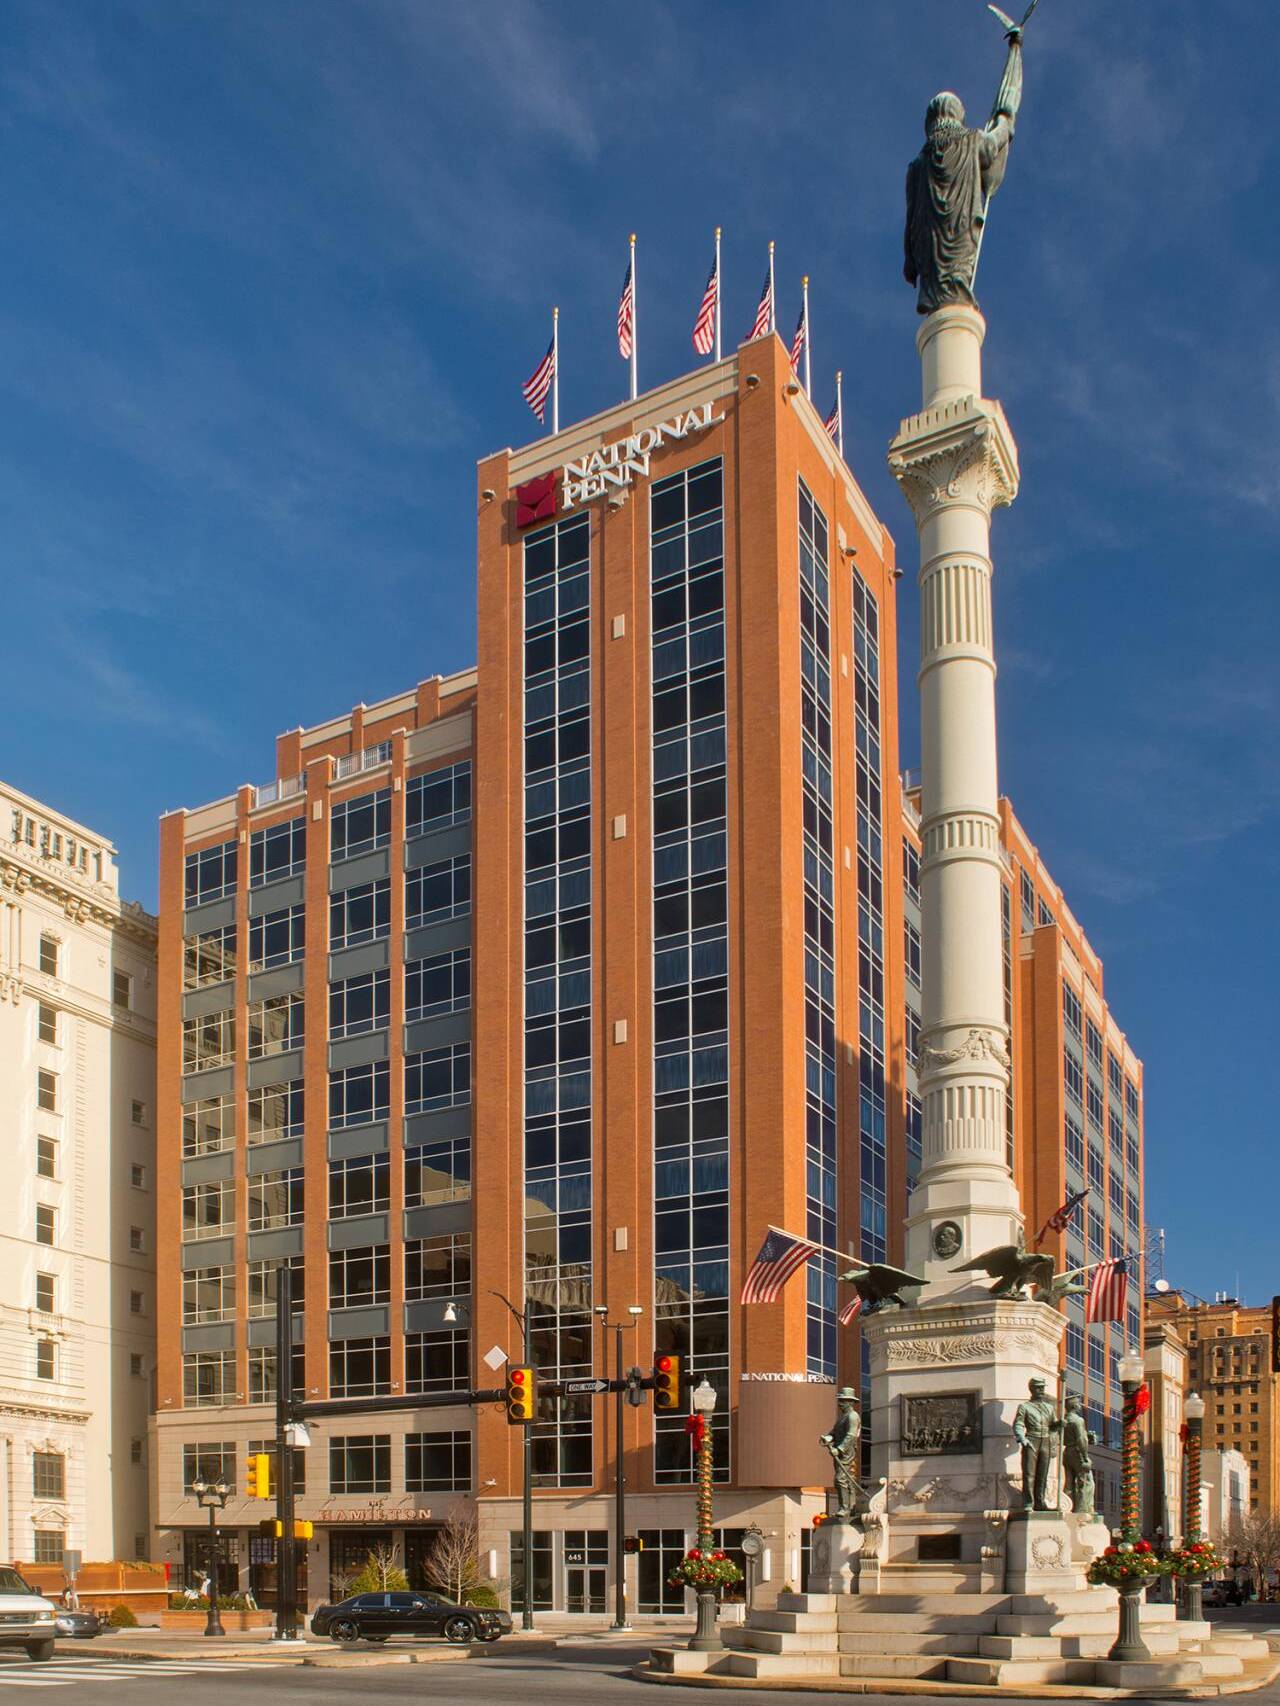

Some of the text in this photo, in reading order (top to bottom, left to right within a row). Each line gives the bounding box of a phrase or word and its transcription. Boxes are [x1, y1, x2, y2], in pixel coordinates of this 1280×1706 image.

[562, 401, 726, 486] NATIONAL
[561, 452, 651, 511] PENN
[751, 1373, 834, 1384] NATIONAL PENN
